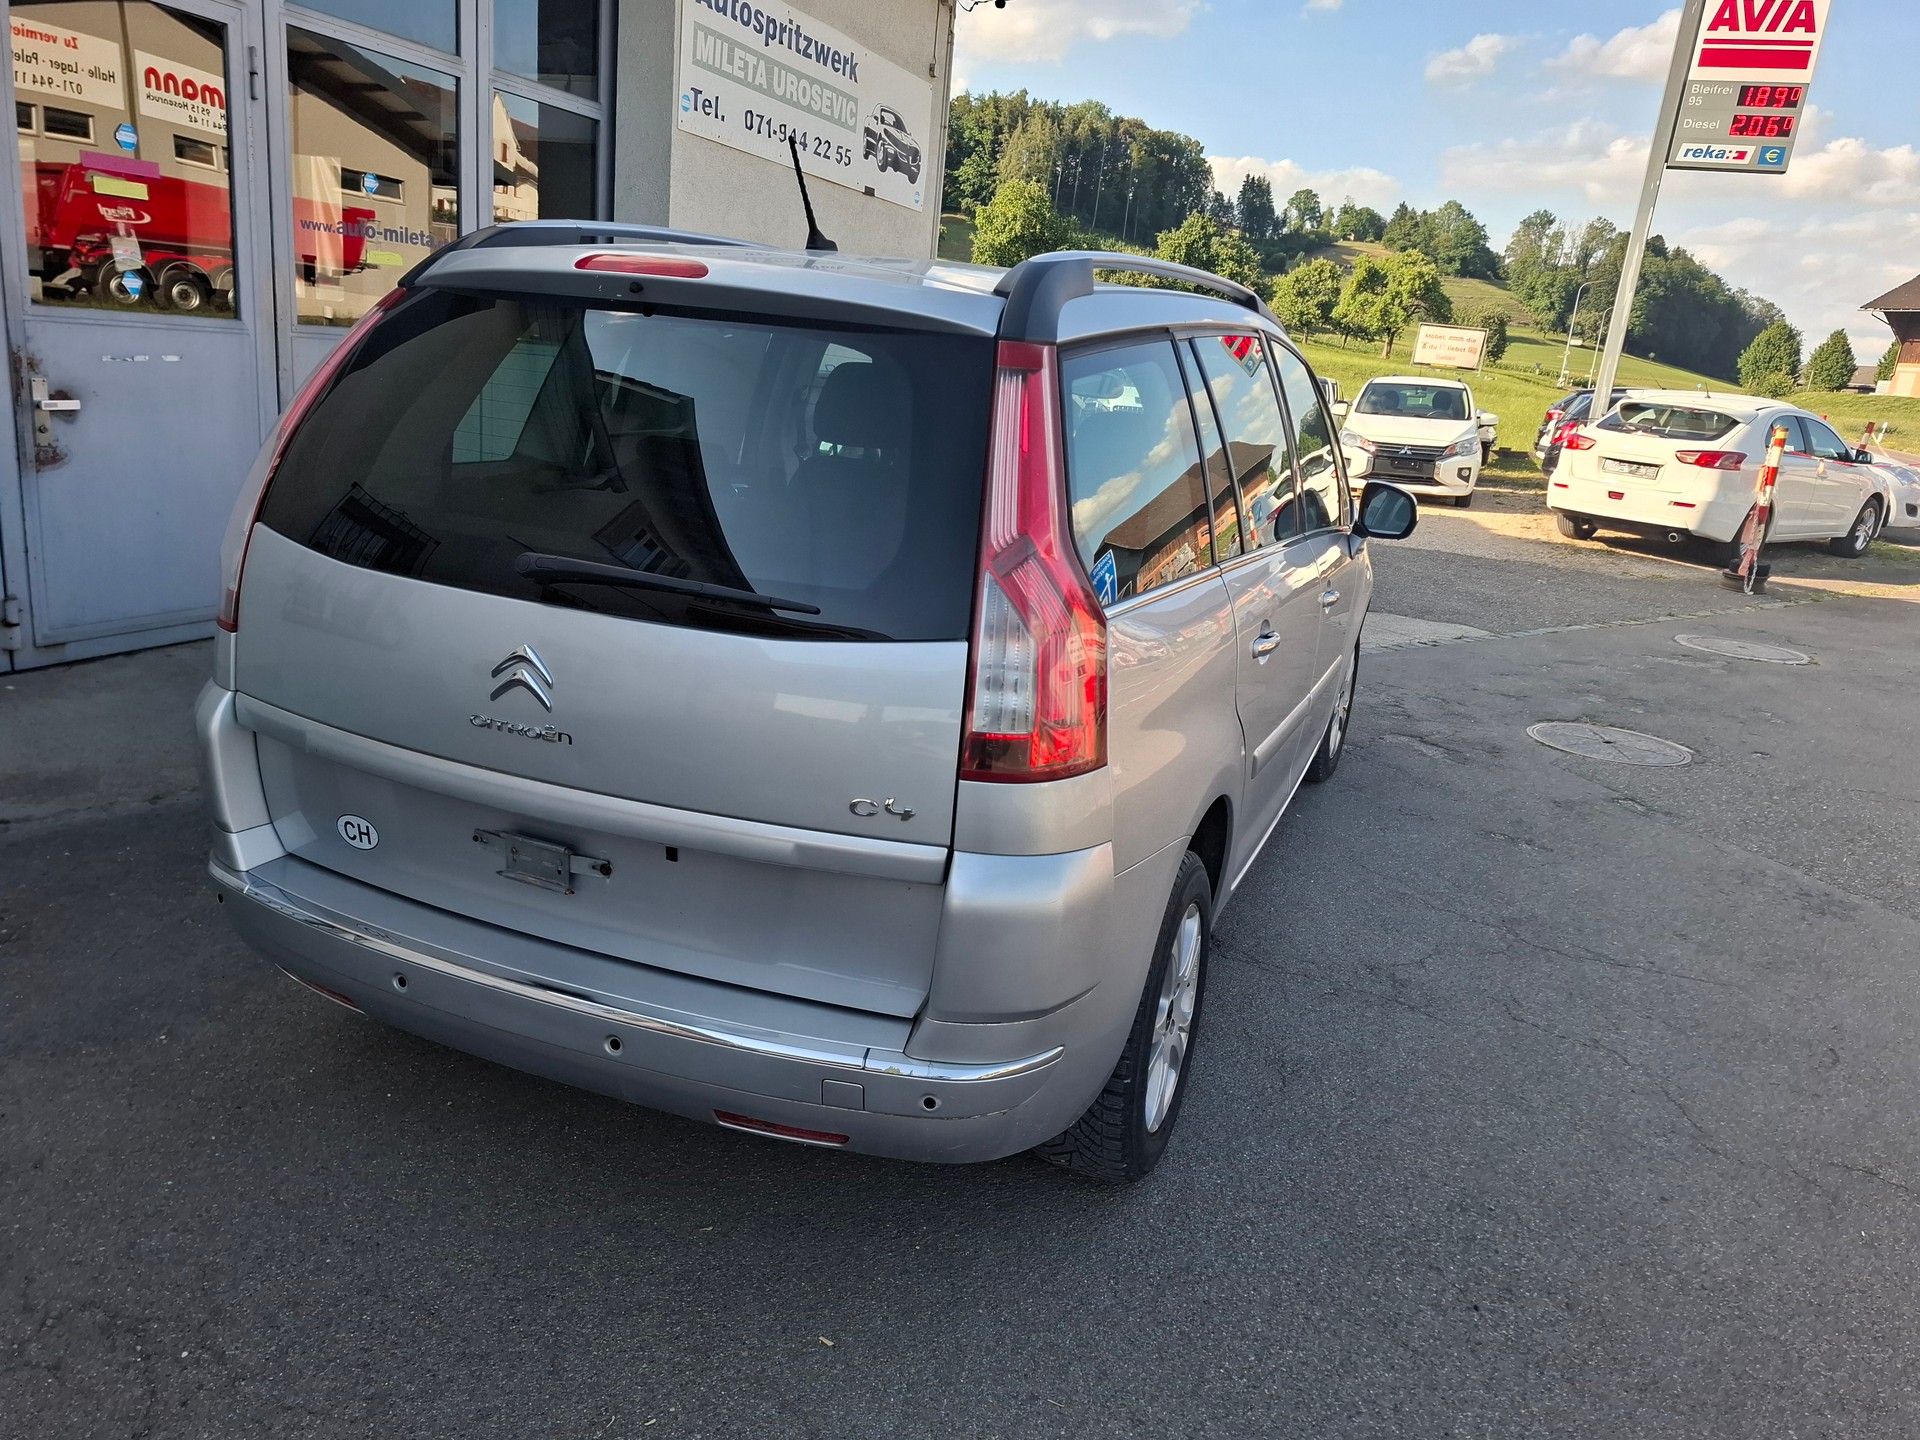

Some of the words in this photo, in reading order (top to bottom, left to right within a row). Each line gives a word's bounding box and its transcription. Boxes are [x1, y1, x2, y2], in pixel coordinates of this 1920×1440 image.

[1706, 0, 1816, 33] AVIA
[696, 30, 768, 90] MILETA
[773, 67, 857, 127] UROSEVIC
[1691, 84, 1734, 95] Bleifrei
[1688, 96, 1703, 106] 95
[690, 87, 726, 122] Tel.
[744, 109, 808, 152] 071-944
[813, 136, 832, 160] 22
[835, 145, 852, 167] 55
[1683, 119, 1719, 130] Diesel
[849, 797, 916, 821] C4
[344, 820, 372, 845] CH
